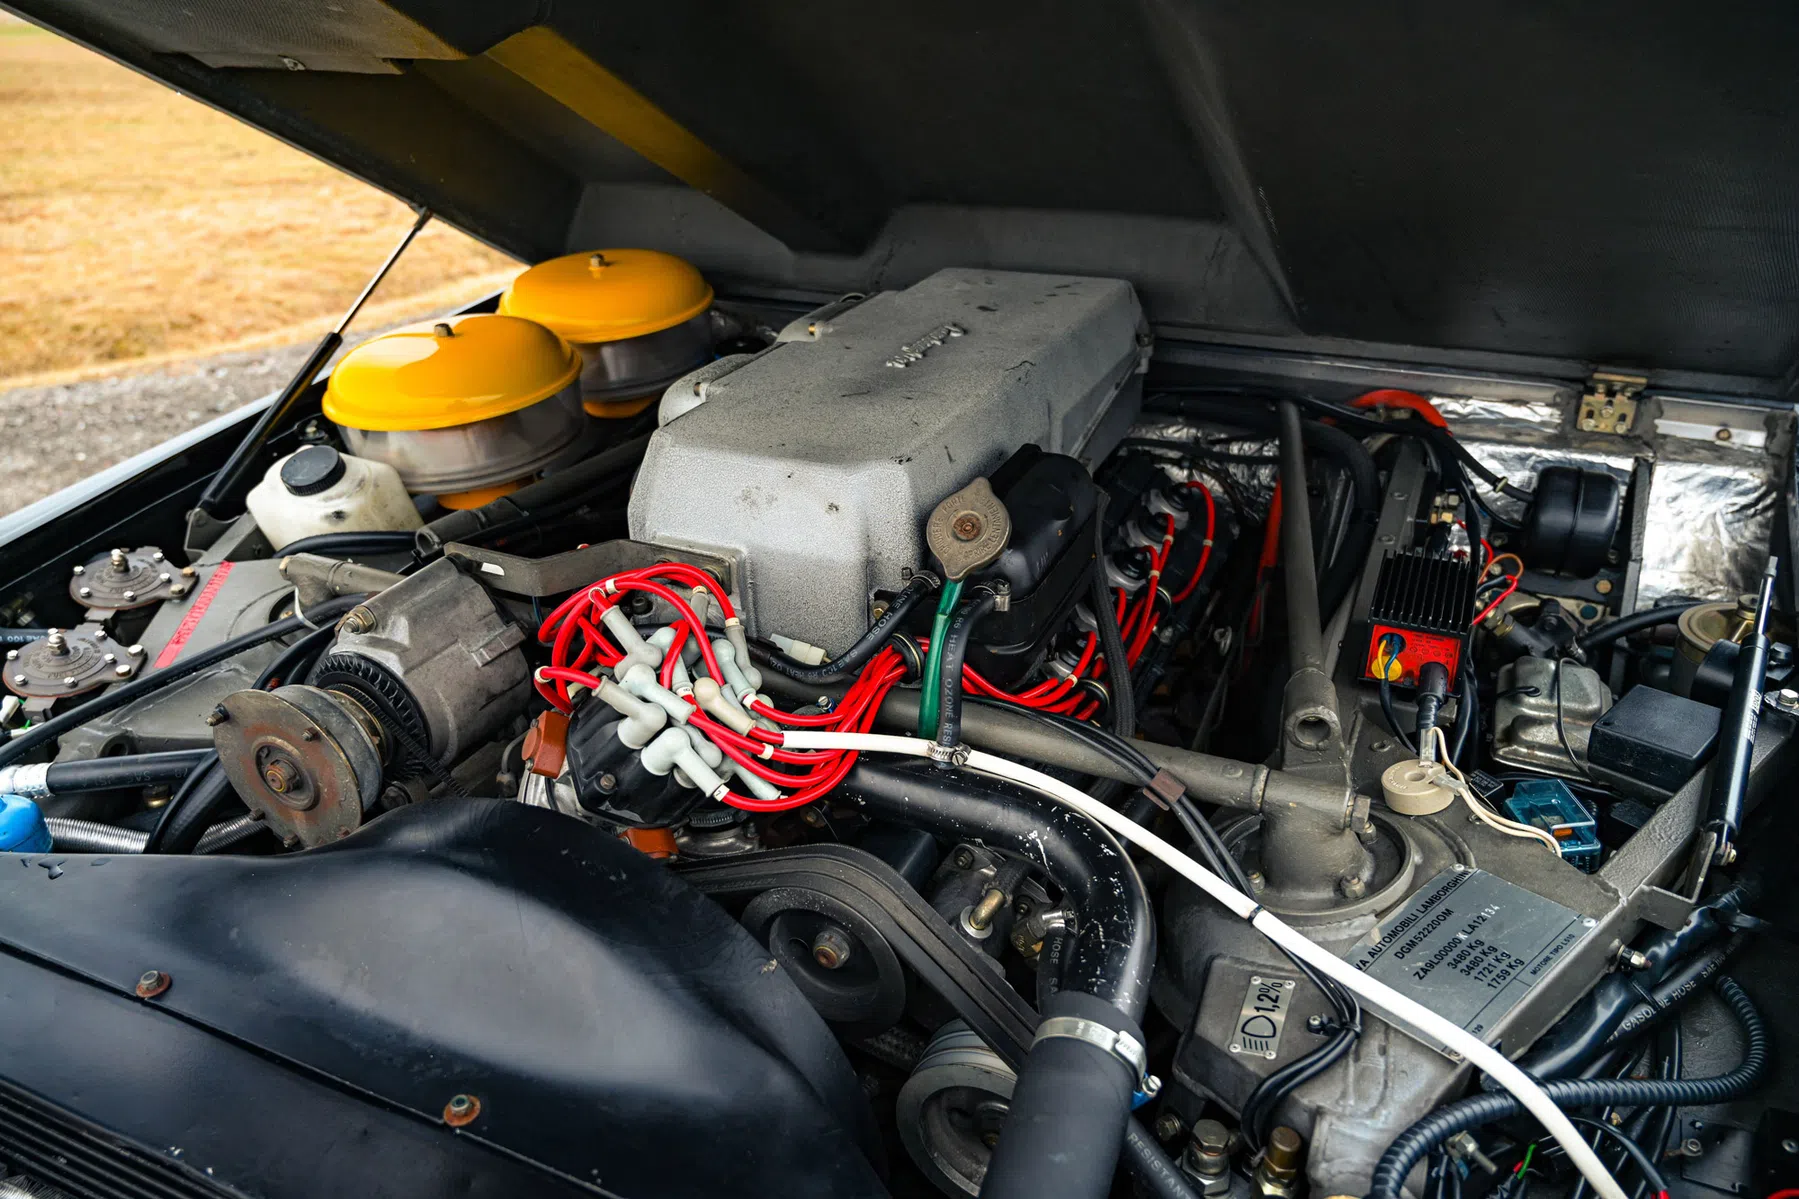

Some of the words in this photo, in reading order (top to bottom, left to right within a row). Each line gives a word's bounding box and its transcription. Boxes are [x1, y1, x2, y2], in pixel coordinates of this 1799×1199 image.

[7, 634, 25, 642] 100
[866, 611, 894, 641] HOSE
[838, 649, 858, 668] SAE
[945, 634, 958, 671] HEAT
[944, 678, 954, 718] OZONE
[1051, 936, 1063, 965] HOSE
[1368, 913, 1420, 958] AUTOMOBILI
[1447, 946, 1472, 971] 3480
[1469, 938, 1485, 954] Kg
[1460, 953, 1485, 977] 3480
[1482, 944, 1498, 960] Kg
[1474, 960, 1496, 983] 1721
[1494, 951, 1511, 967] Kg
[1530, 952, 1554, 976] MOTORE
[1487, 967, 1510, 990] 1759
[1508, 957, 1525, 974] Kg
[1254, 982, 1283, 1012] 1,2%
[1672, 980, 1698, 999] HOSE
